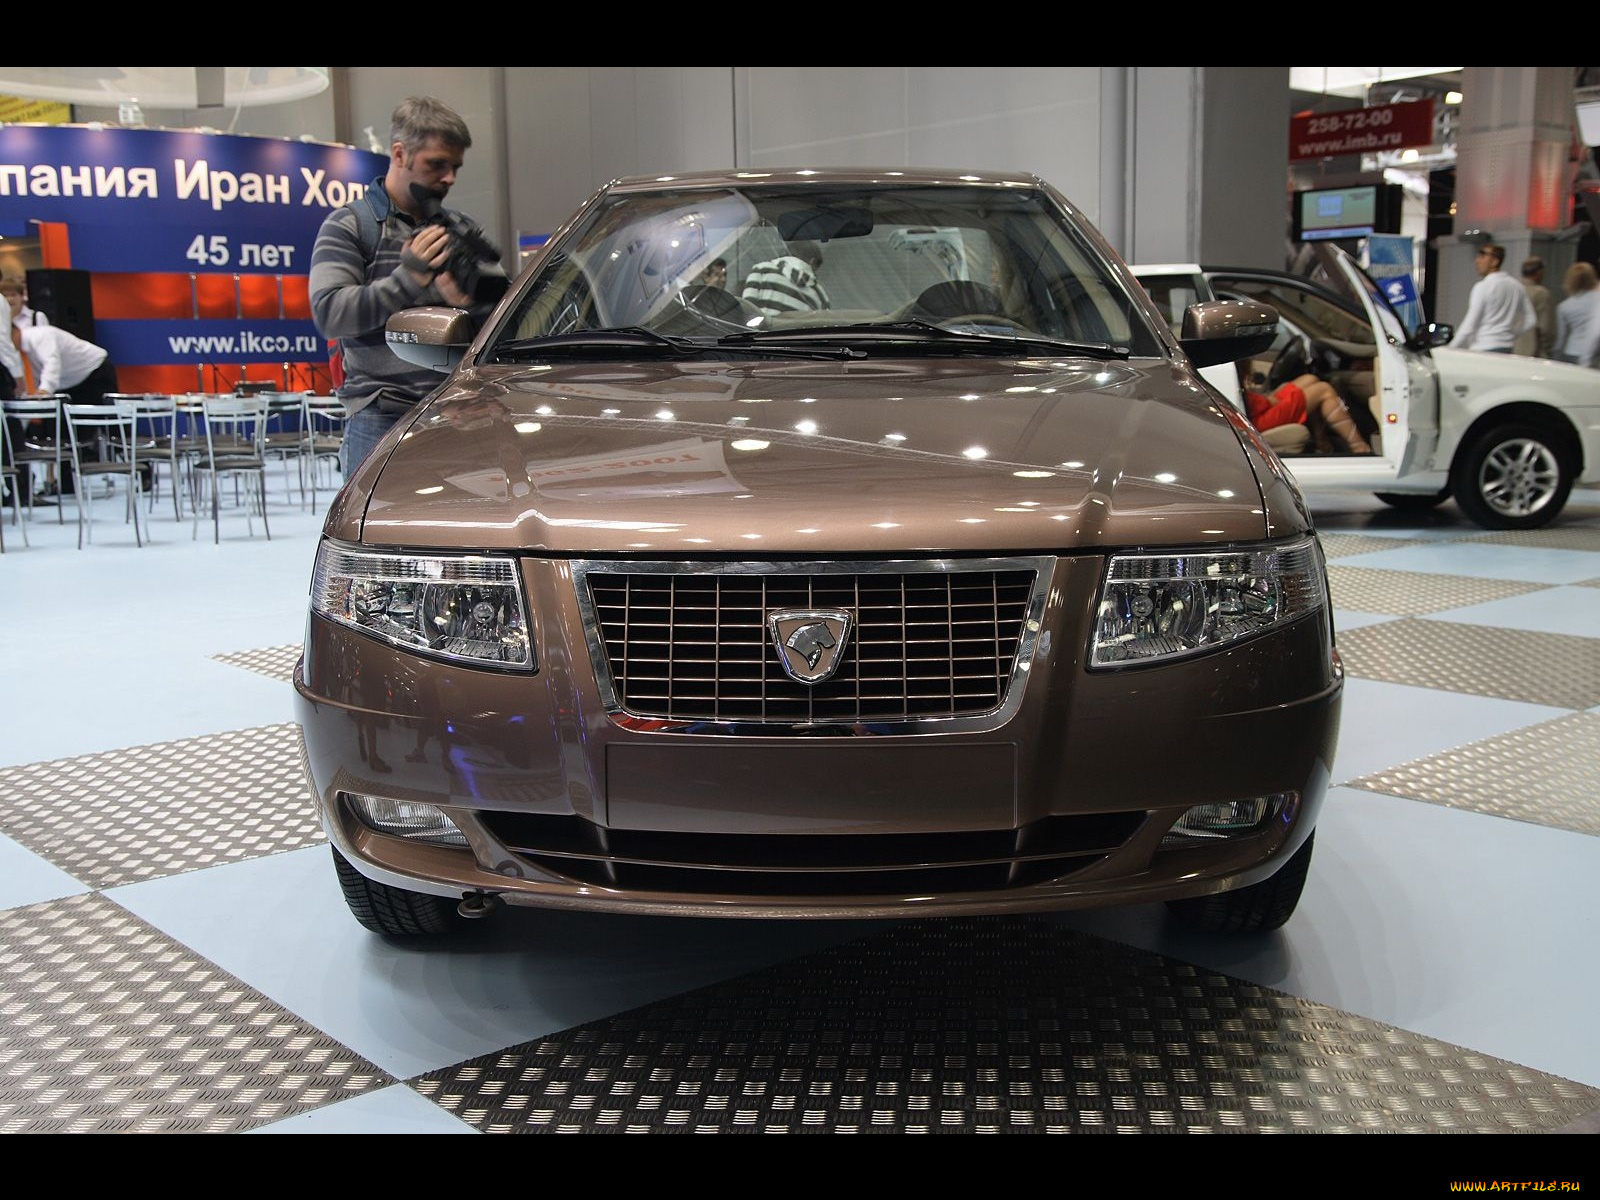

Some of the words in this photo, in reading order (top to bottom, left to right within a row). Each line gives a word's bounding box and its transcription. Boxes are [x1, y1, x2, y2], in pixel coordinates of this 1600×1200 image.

[1307, 109, 1393, 134] 258-72-00
[1298, 132, 1402, 155] www.imb.ru
[0, 164, 158, 199] пания
[174, 158, 291, 211] Иран
[300, 166, 370, 209] Хол
[186, 234, 230, 266] 45
[238, 243, 295, 268] лет
[168, 330, 318, 354] www.ikco.ru
